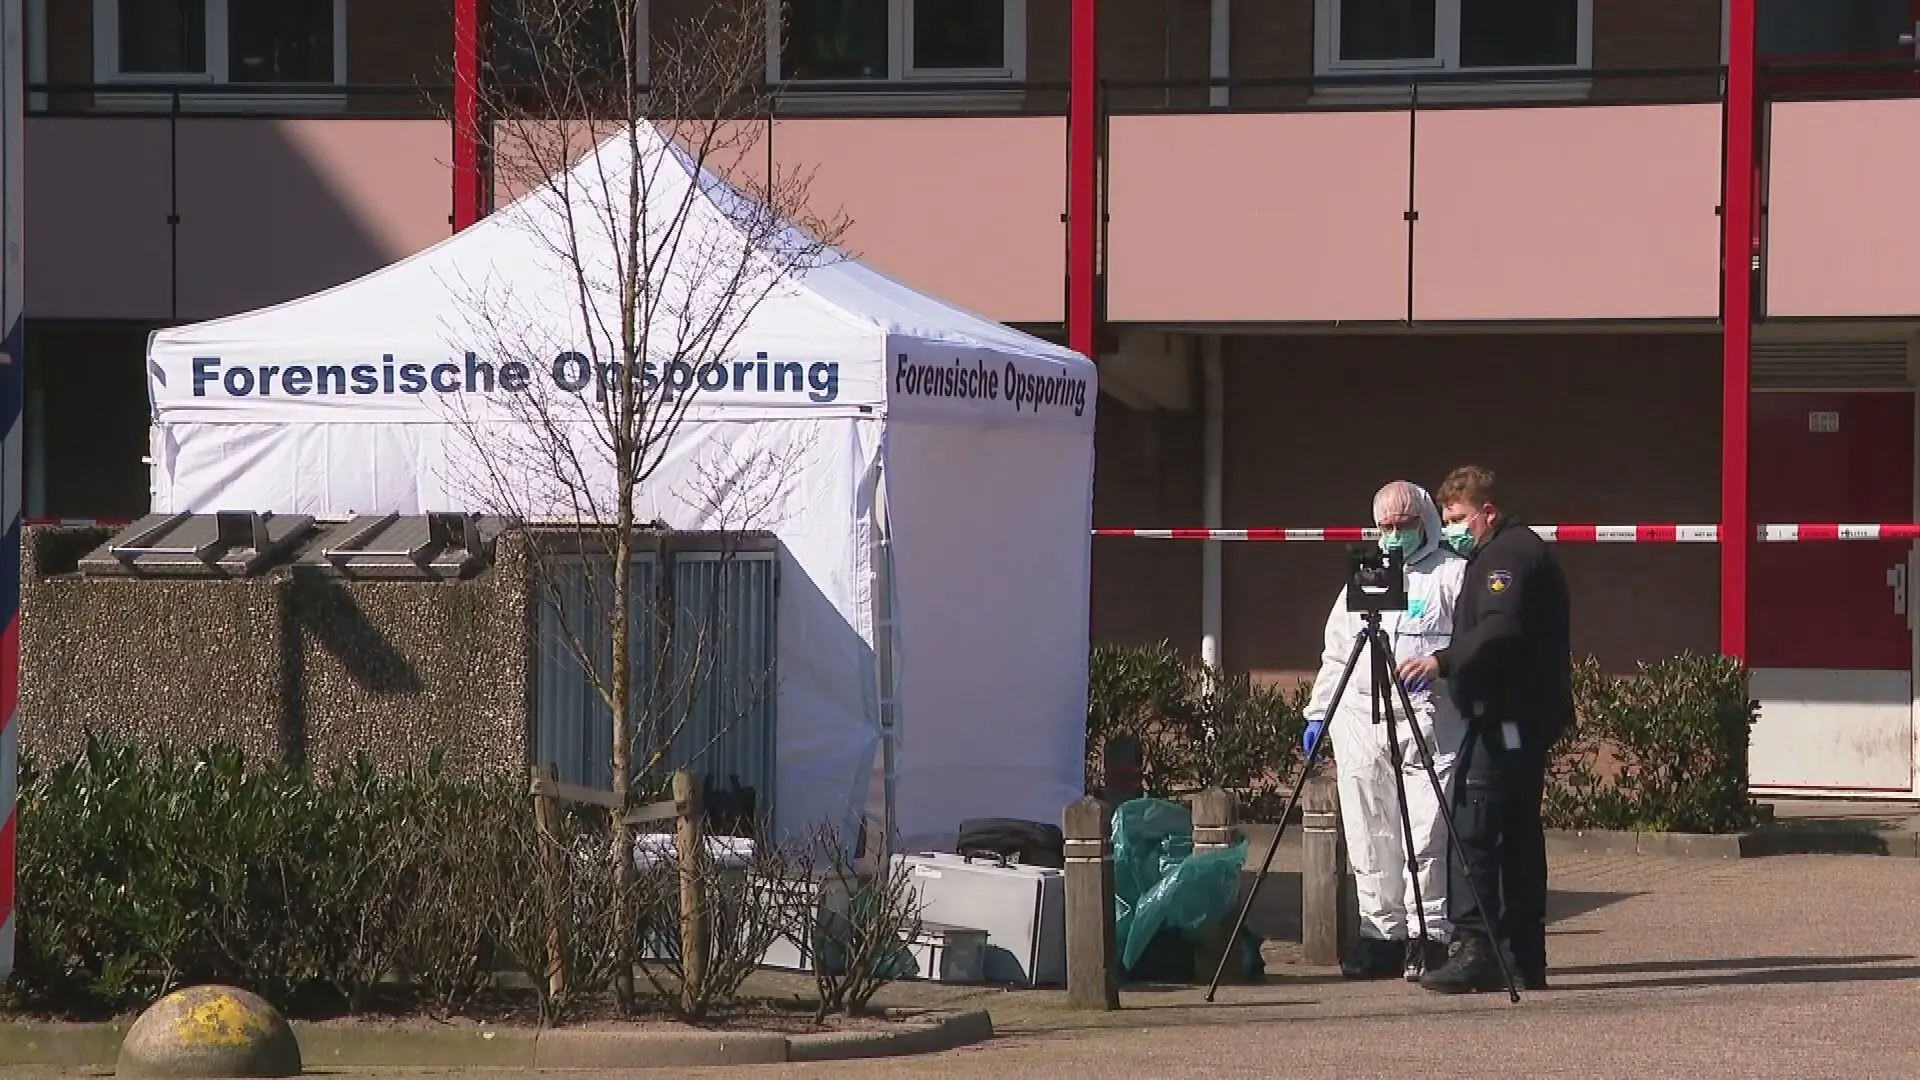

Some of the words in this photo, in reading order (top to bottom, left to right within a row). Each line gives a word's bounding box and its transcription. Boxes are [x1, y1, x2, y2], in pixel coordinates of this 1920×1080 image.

[192, 351, 530, 397] Forensische
[552, 350, 839, 403] Opsporing
[895, 353, 998, 400] Forensische
[1004, 361, 1087, 417] Opsporing
